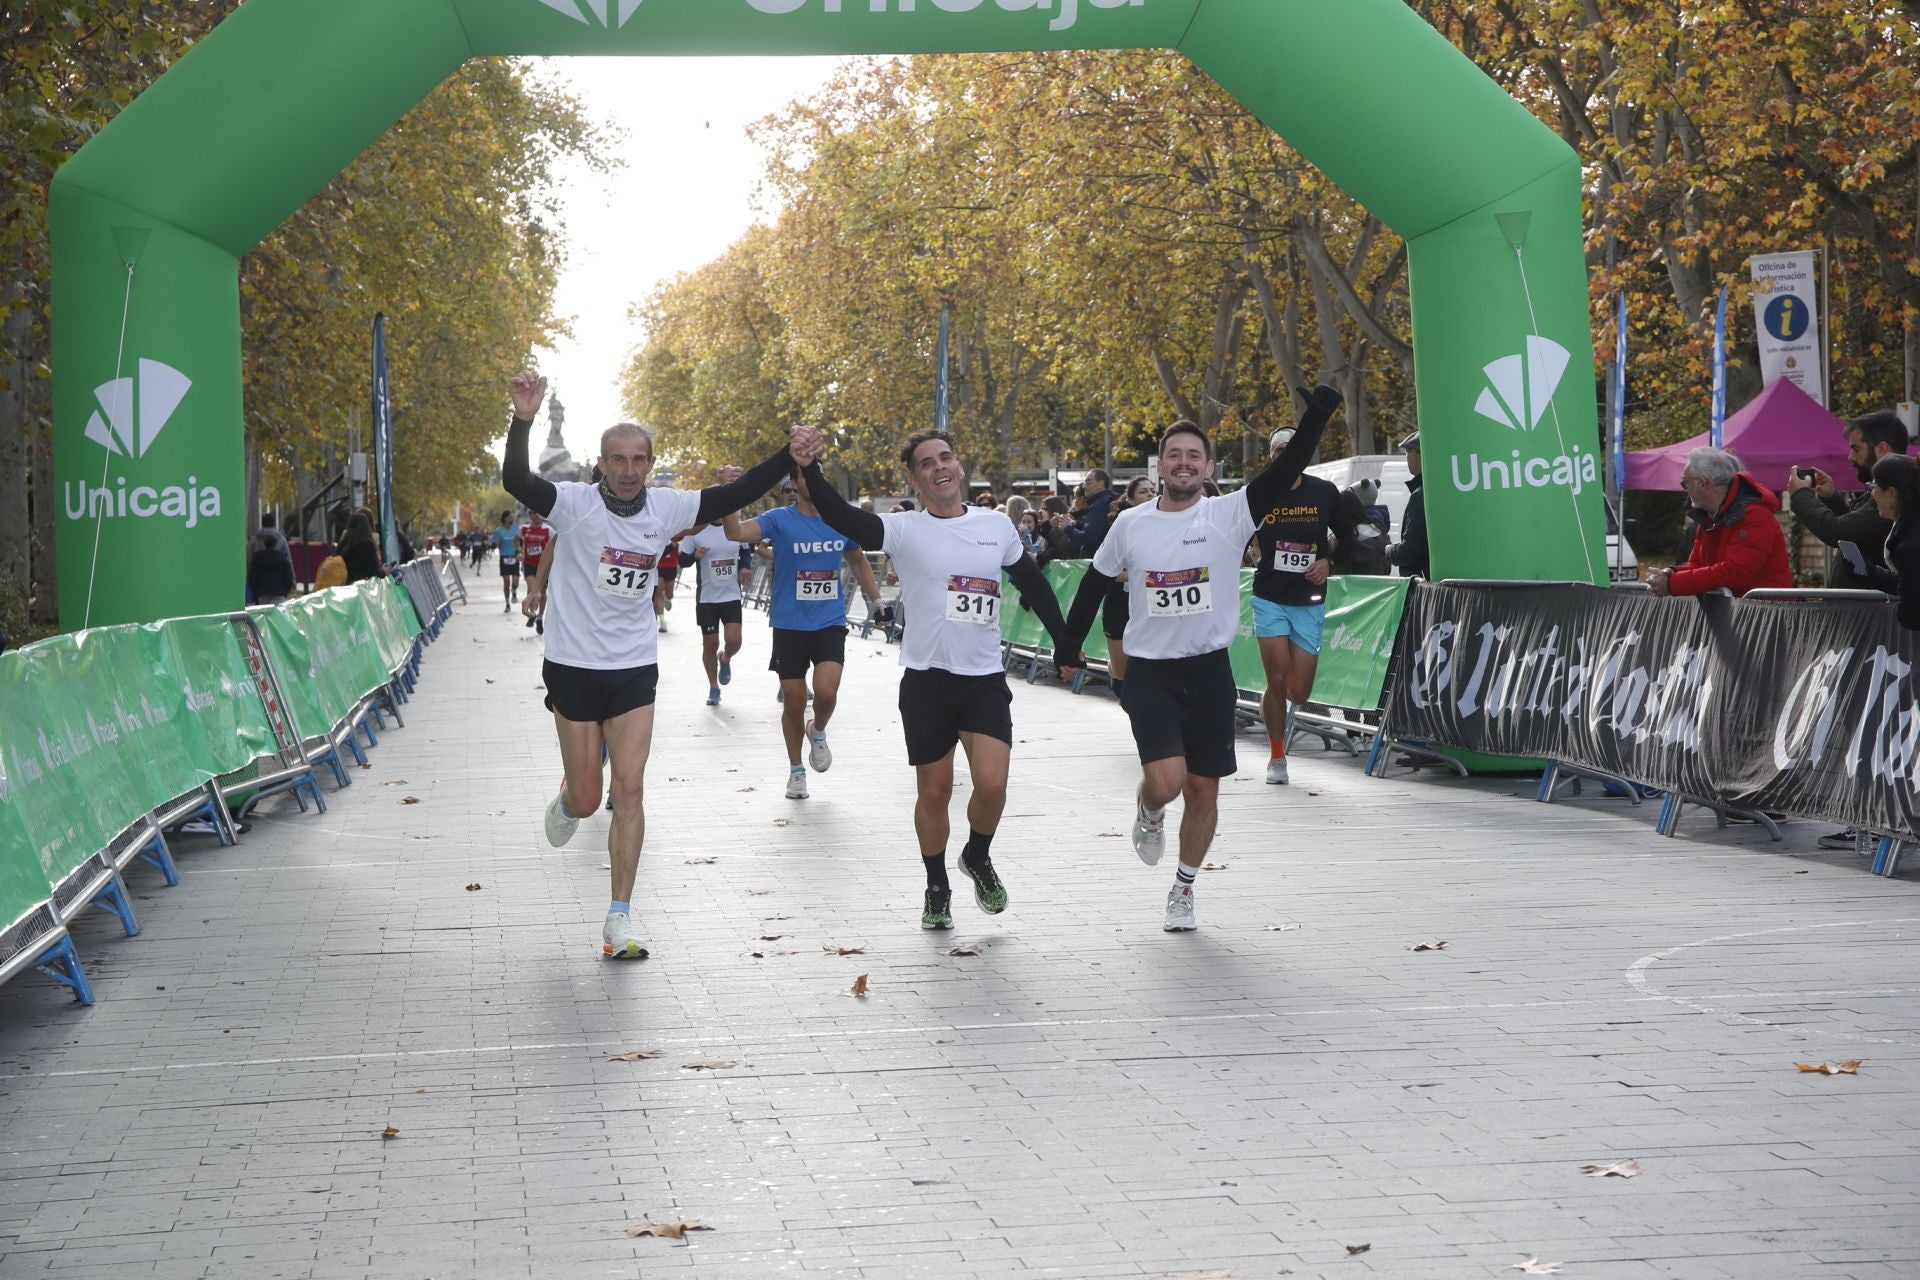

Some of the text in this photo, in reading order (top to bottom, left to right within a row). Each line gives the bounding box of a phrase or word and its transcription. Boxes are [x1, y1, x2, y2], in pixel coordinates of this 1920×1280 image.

[1758, 260, 1797, 272] Oficina de
[1451, 444, 1596, 496] Unicaja
[64, 475, 221, 529] Unicaja
[1281, 506, 1318, 515] CellMat
[793, 539, 844, 554] IVECO
[1281, 553, 1310, 567] 195
[606, 567, 649, 590] 312
[715, 566, 733, 576] 958
[802, 582, 832, 594] 576
[1155, 586, 1201, 608] 310
[955, 594, 994, 616] 311
